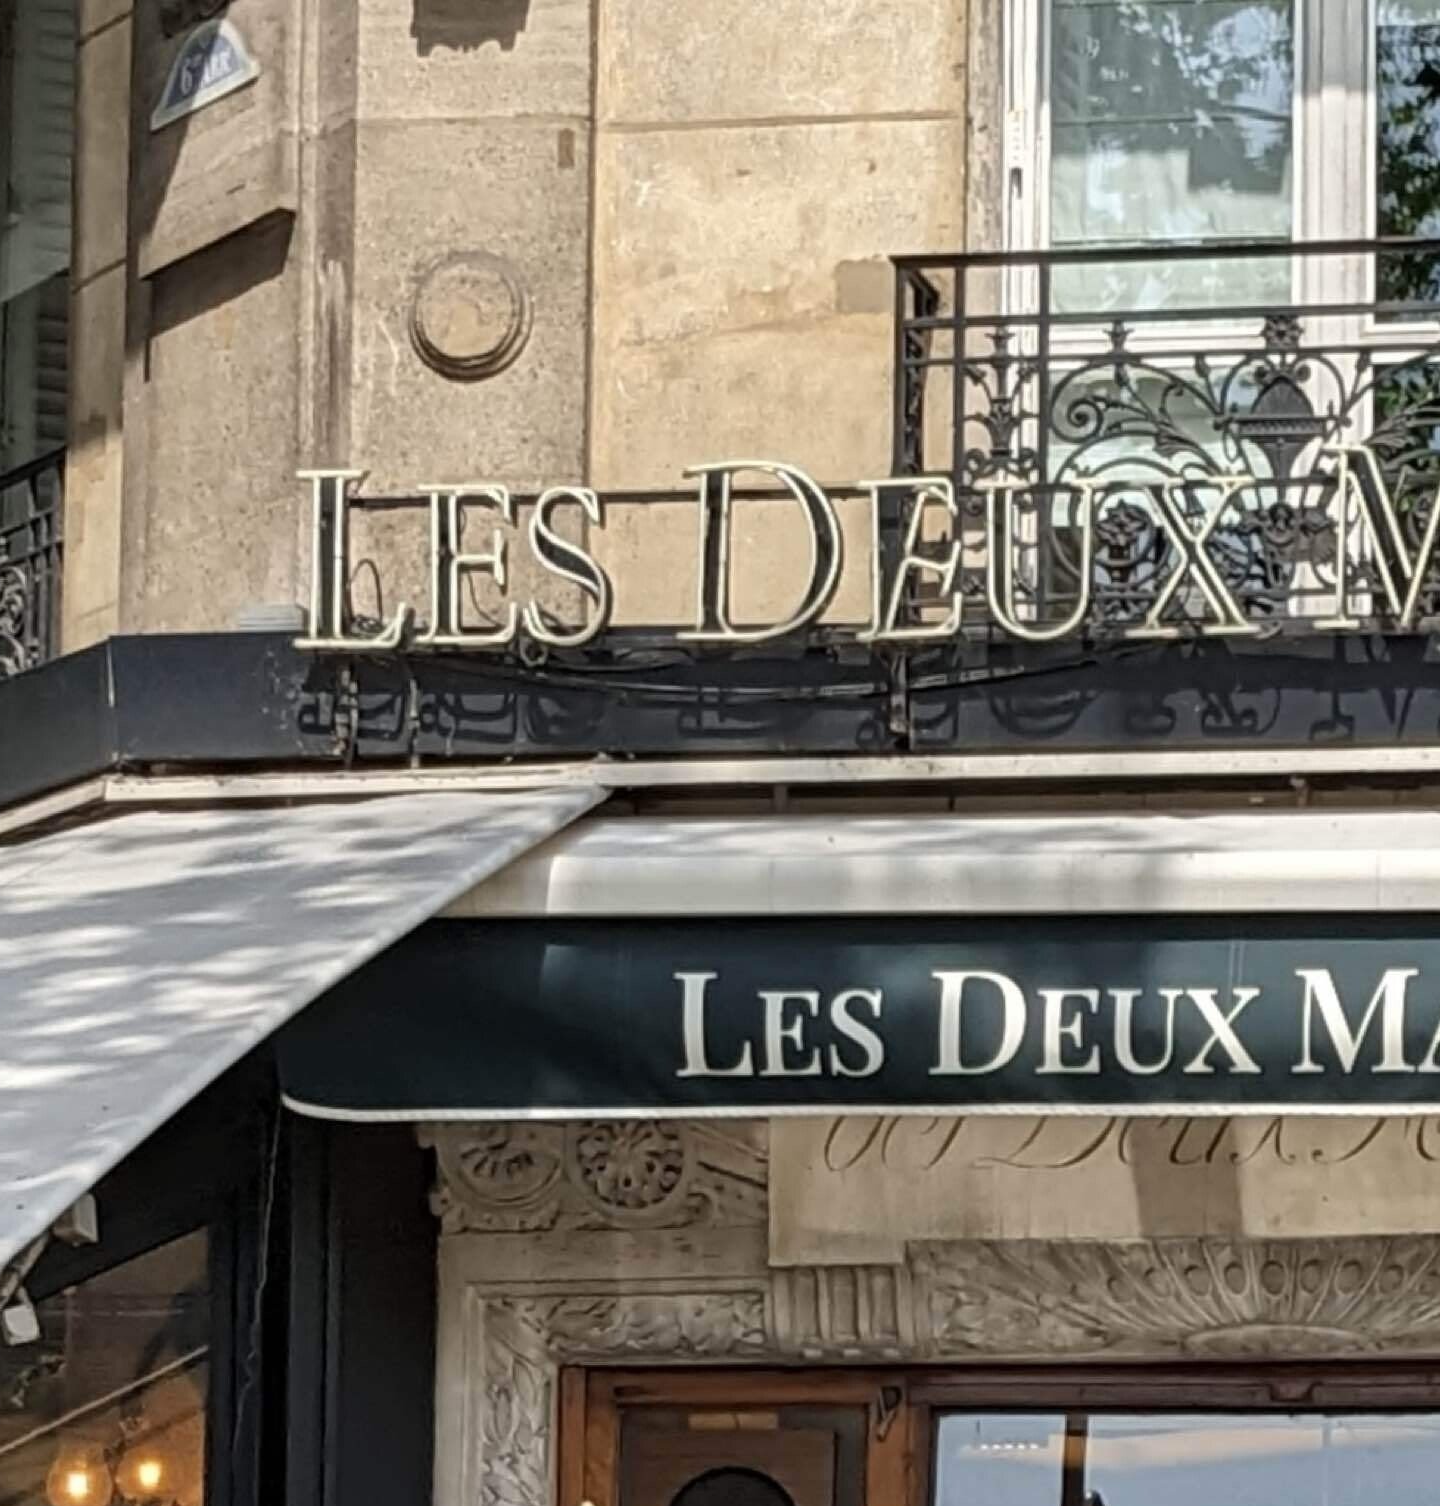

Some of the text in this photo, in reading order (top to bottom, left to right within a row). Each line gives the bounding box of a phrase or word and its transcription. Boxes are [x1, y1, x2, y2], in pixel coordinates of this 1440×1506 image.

[293, 469, 613, 649] LES
[676, 460, 1263, 642] DEUX
[675, 970, 885, 1079] LES
[927, 968, 1263, 1078] DEUX
